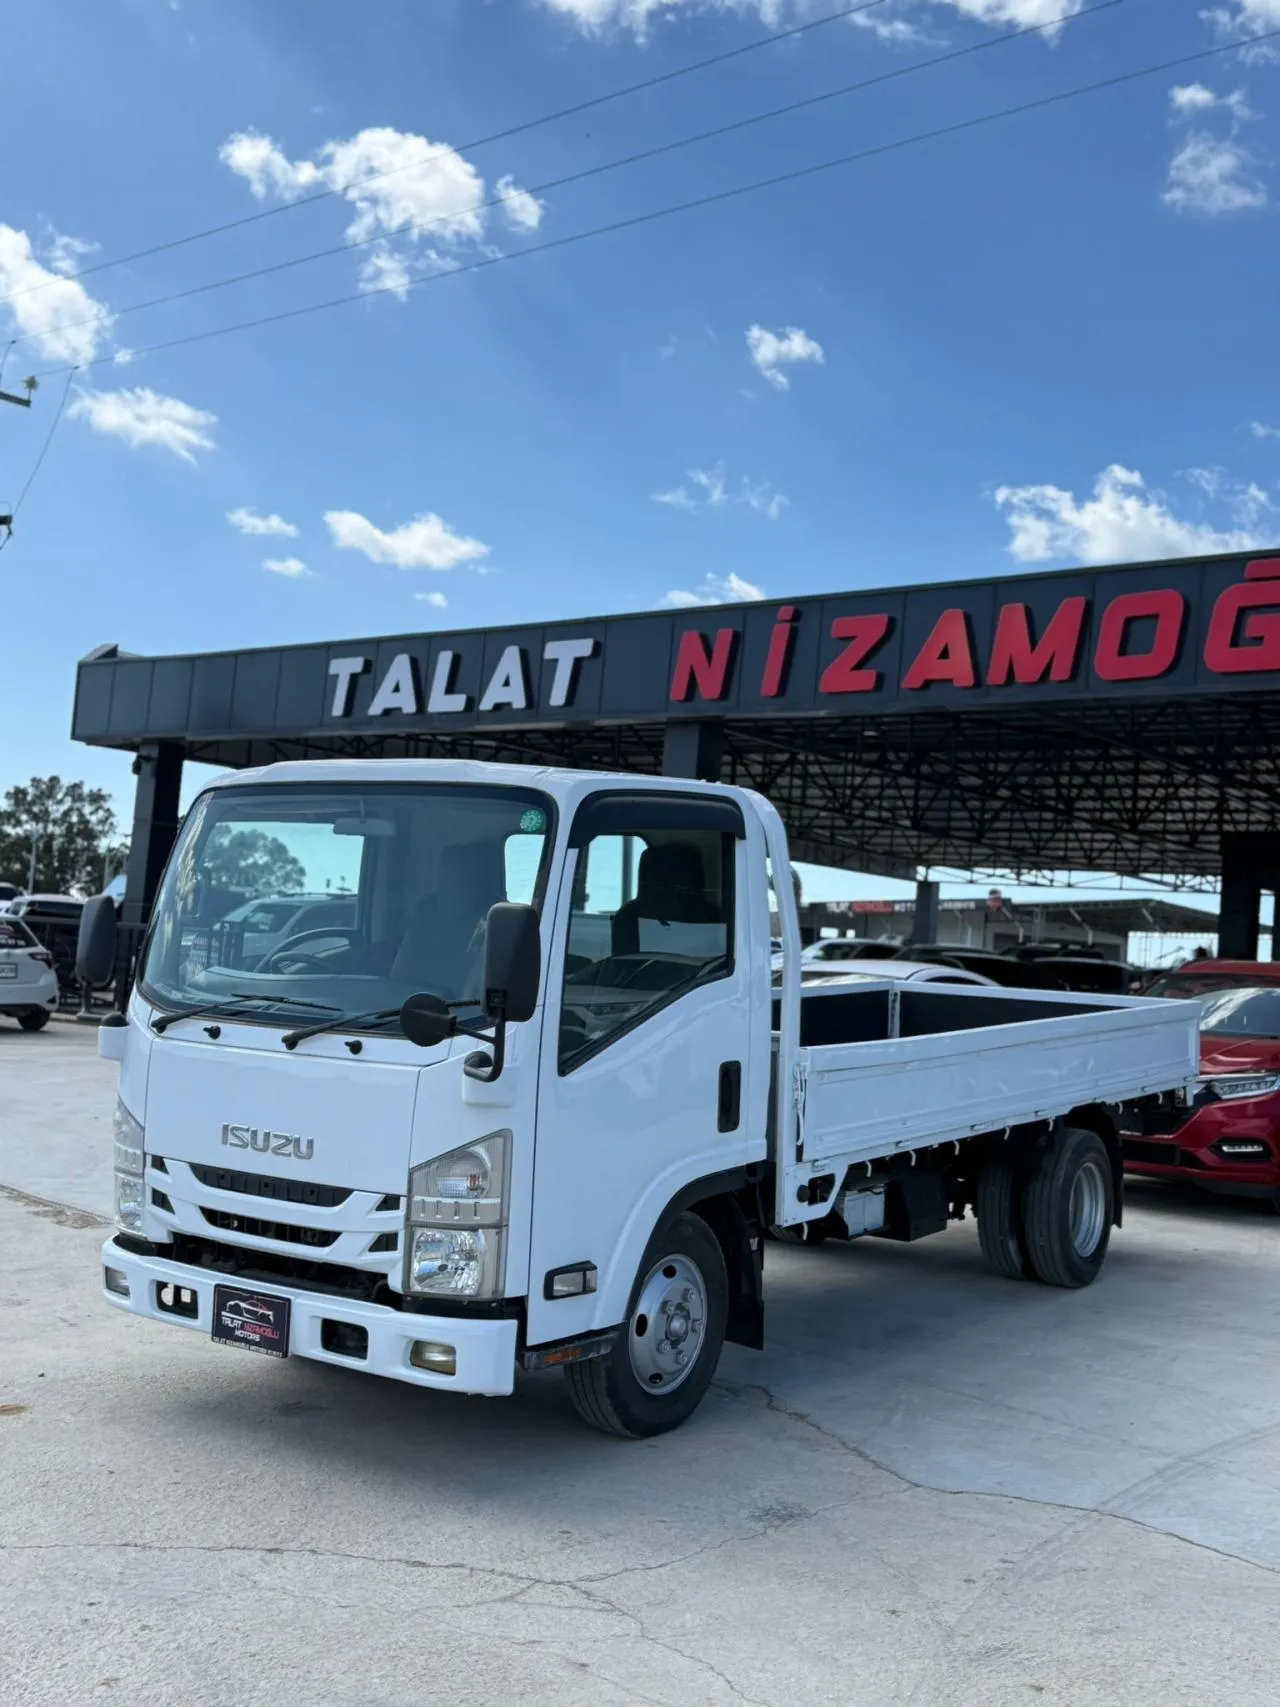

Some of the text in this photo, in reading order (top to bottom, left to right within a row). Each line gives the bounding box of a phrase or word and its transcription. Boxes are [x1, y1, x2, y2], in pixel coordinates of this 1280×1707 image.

[328, 638, 595, 717] TALAT
[221, 1122, 314, 1160] ISUZU
[221, 1316, 243, 1330] TALAT
[234, 1329, 261, 1342] MOTORS
